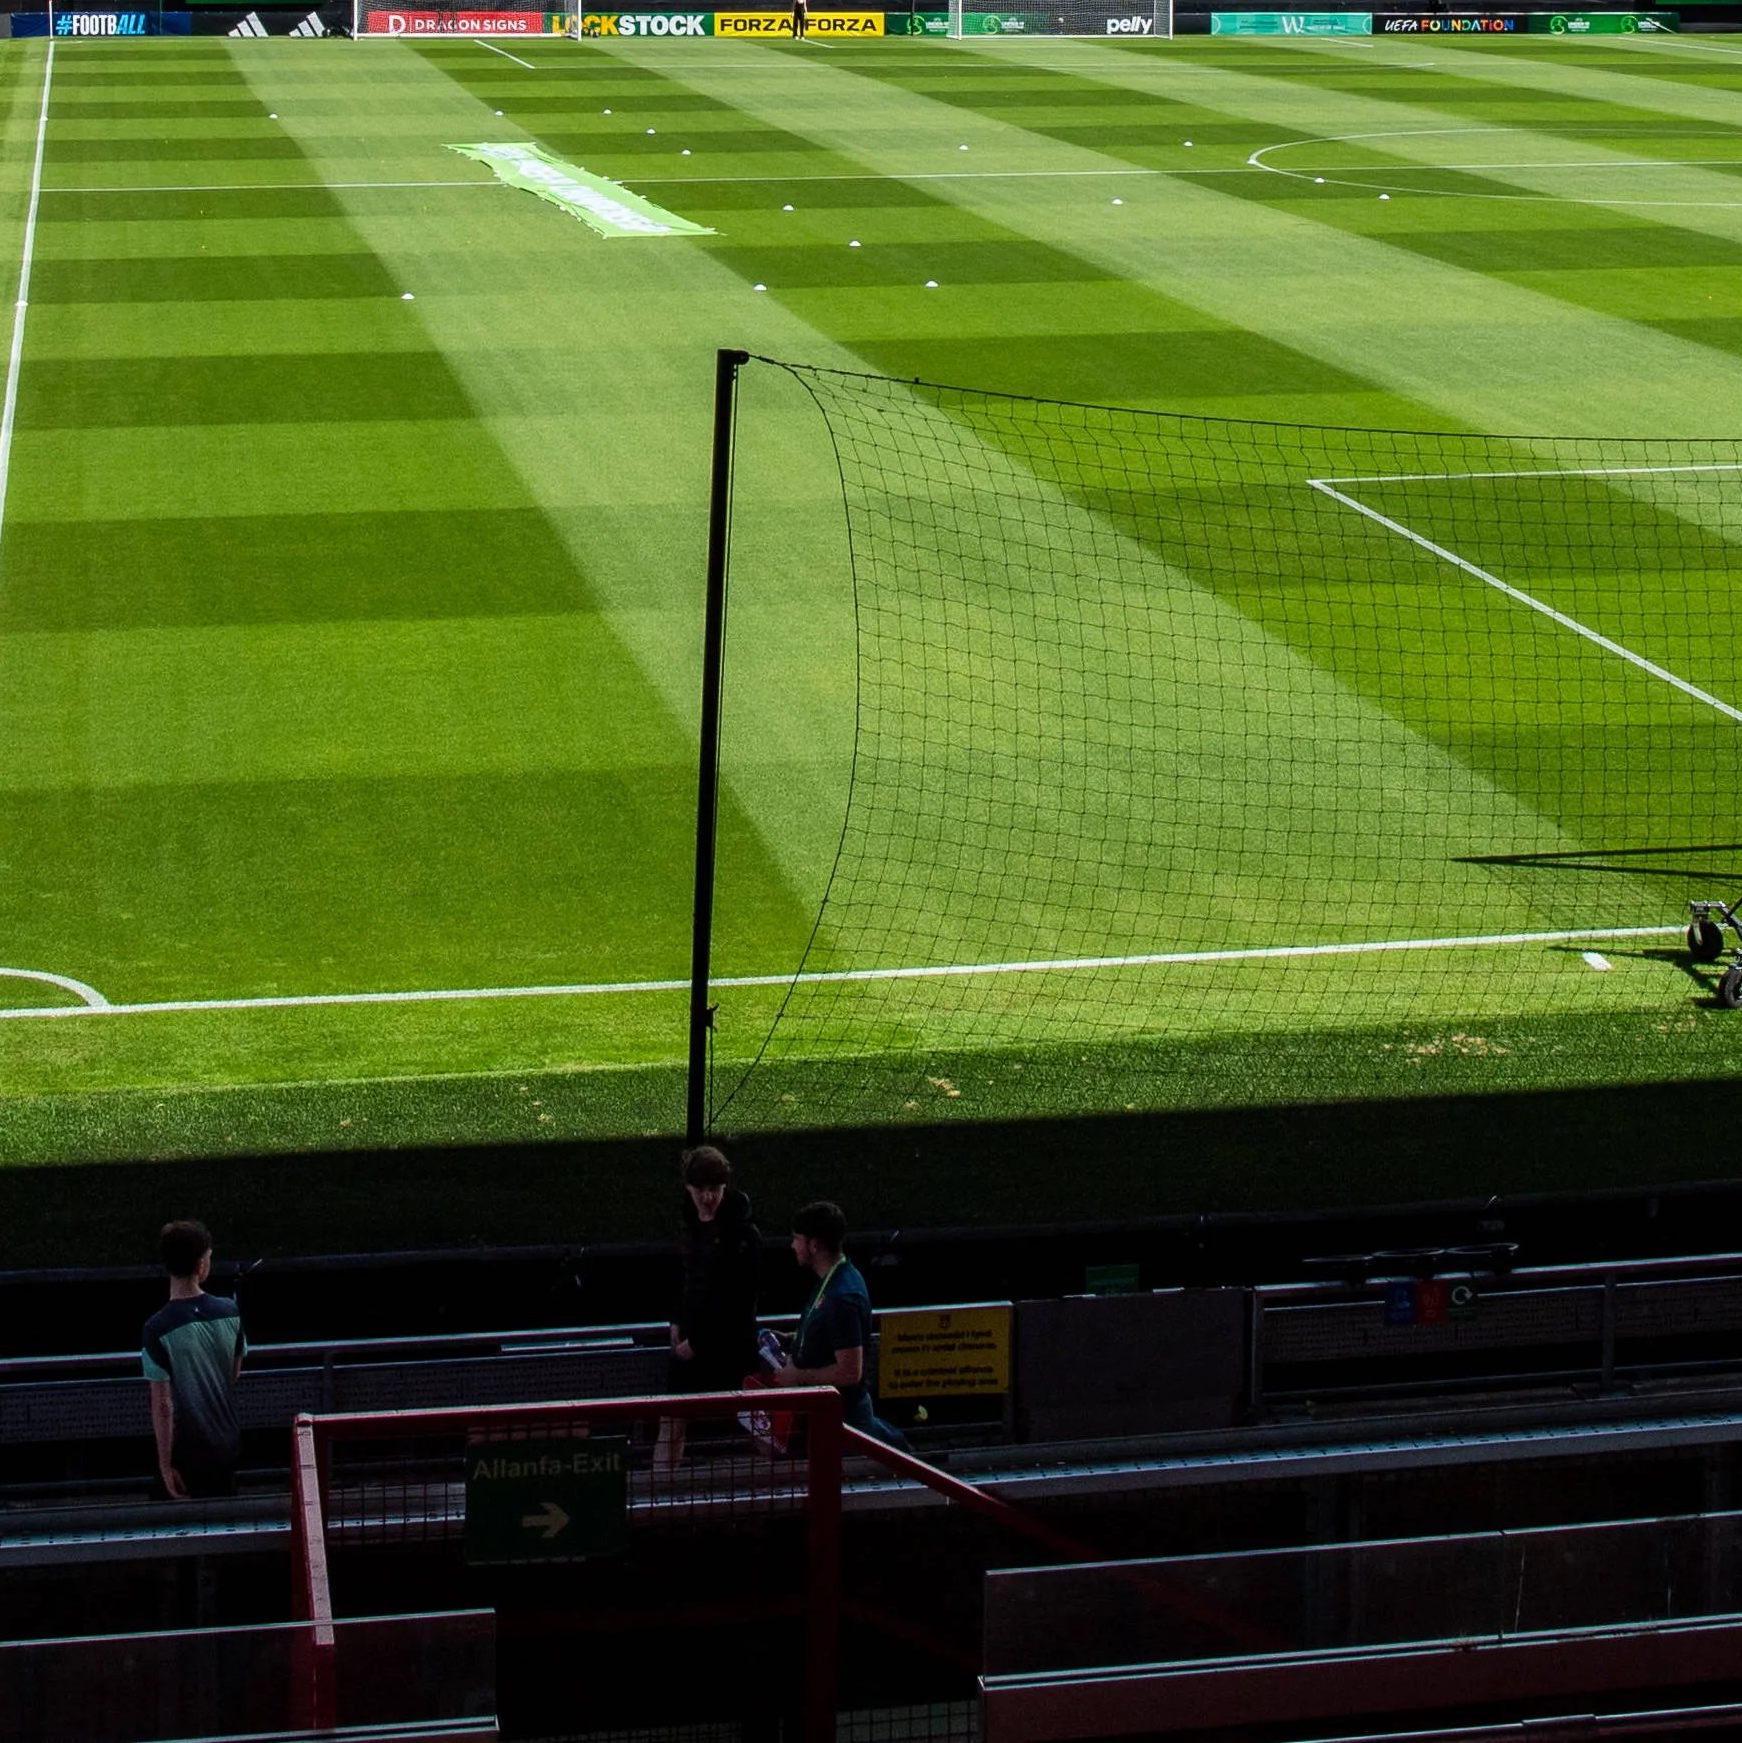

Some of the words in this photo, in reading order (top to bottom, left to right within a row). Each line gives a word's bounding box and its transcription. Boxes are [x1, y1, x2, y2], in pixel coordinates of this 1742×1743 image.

[56, 13, 147, 36] #FOOTBALL
[415, 18, 479, 32] DRAGON
[483, 18, 527, 32] SIGNS
[553, 15, 705, 36] LOCKSTOCK
[720, 18, 794, 32] FORZA
[806, 18, 877, 32] FORZA
[1107, 15, 1153, 34] pelly
[1384, 19, 1418, 32] UEFA
[1421, 19, 1515, 32] FOUNDATION
[471, 1451, 623, 1482] Allanfa-Exit
